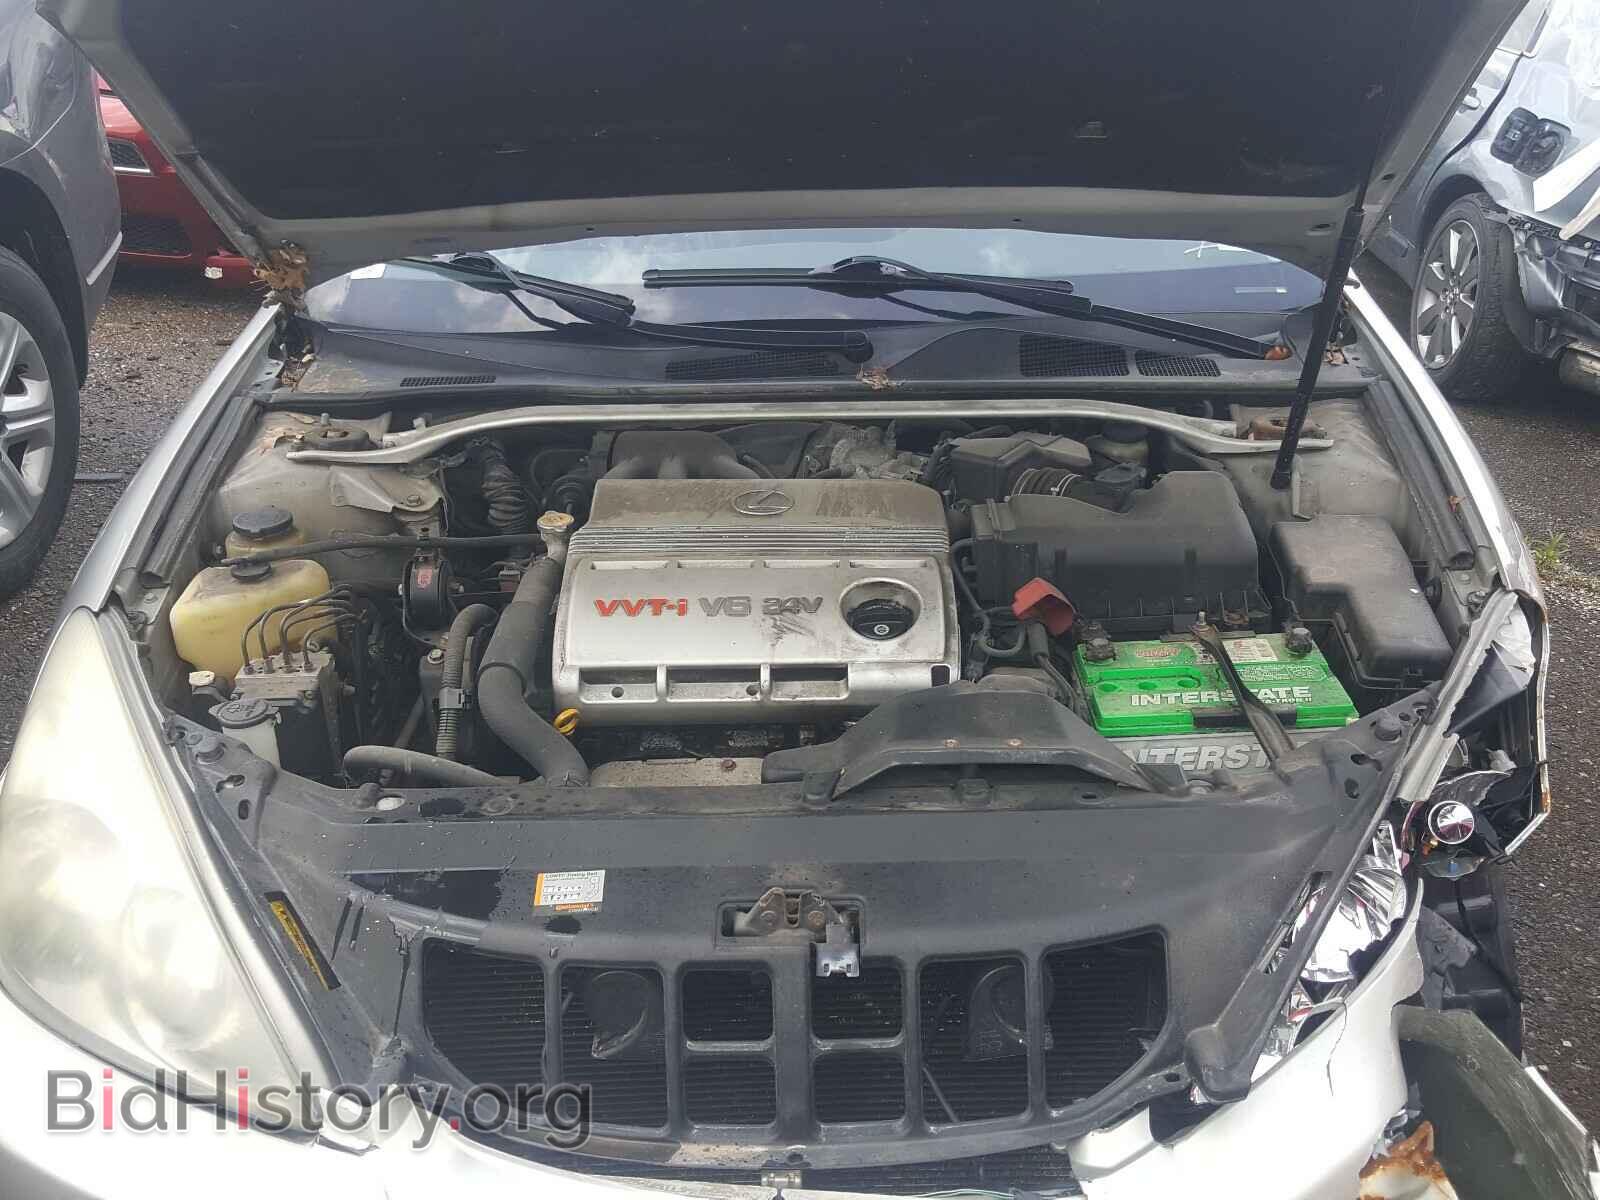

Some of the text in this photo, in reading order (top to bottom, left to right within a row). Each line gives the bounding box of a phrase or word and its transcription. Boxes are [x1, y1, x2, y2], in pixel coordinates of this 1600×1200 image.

[594, 595, 823, 617] VVT-i V6 24V
[1131, 686, 1312, 706] INTERSATE
